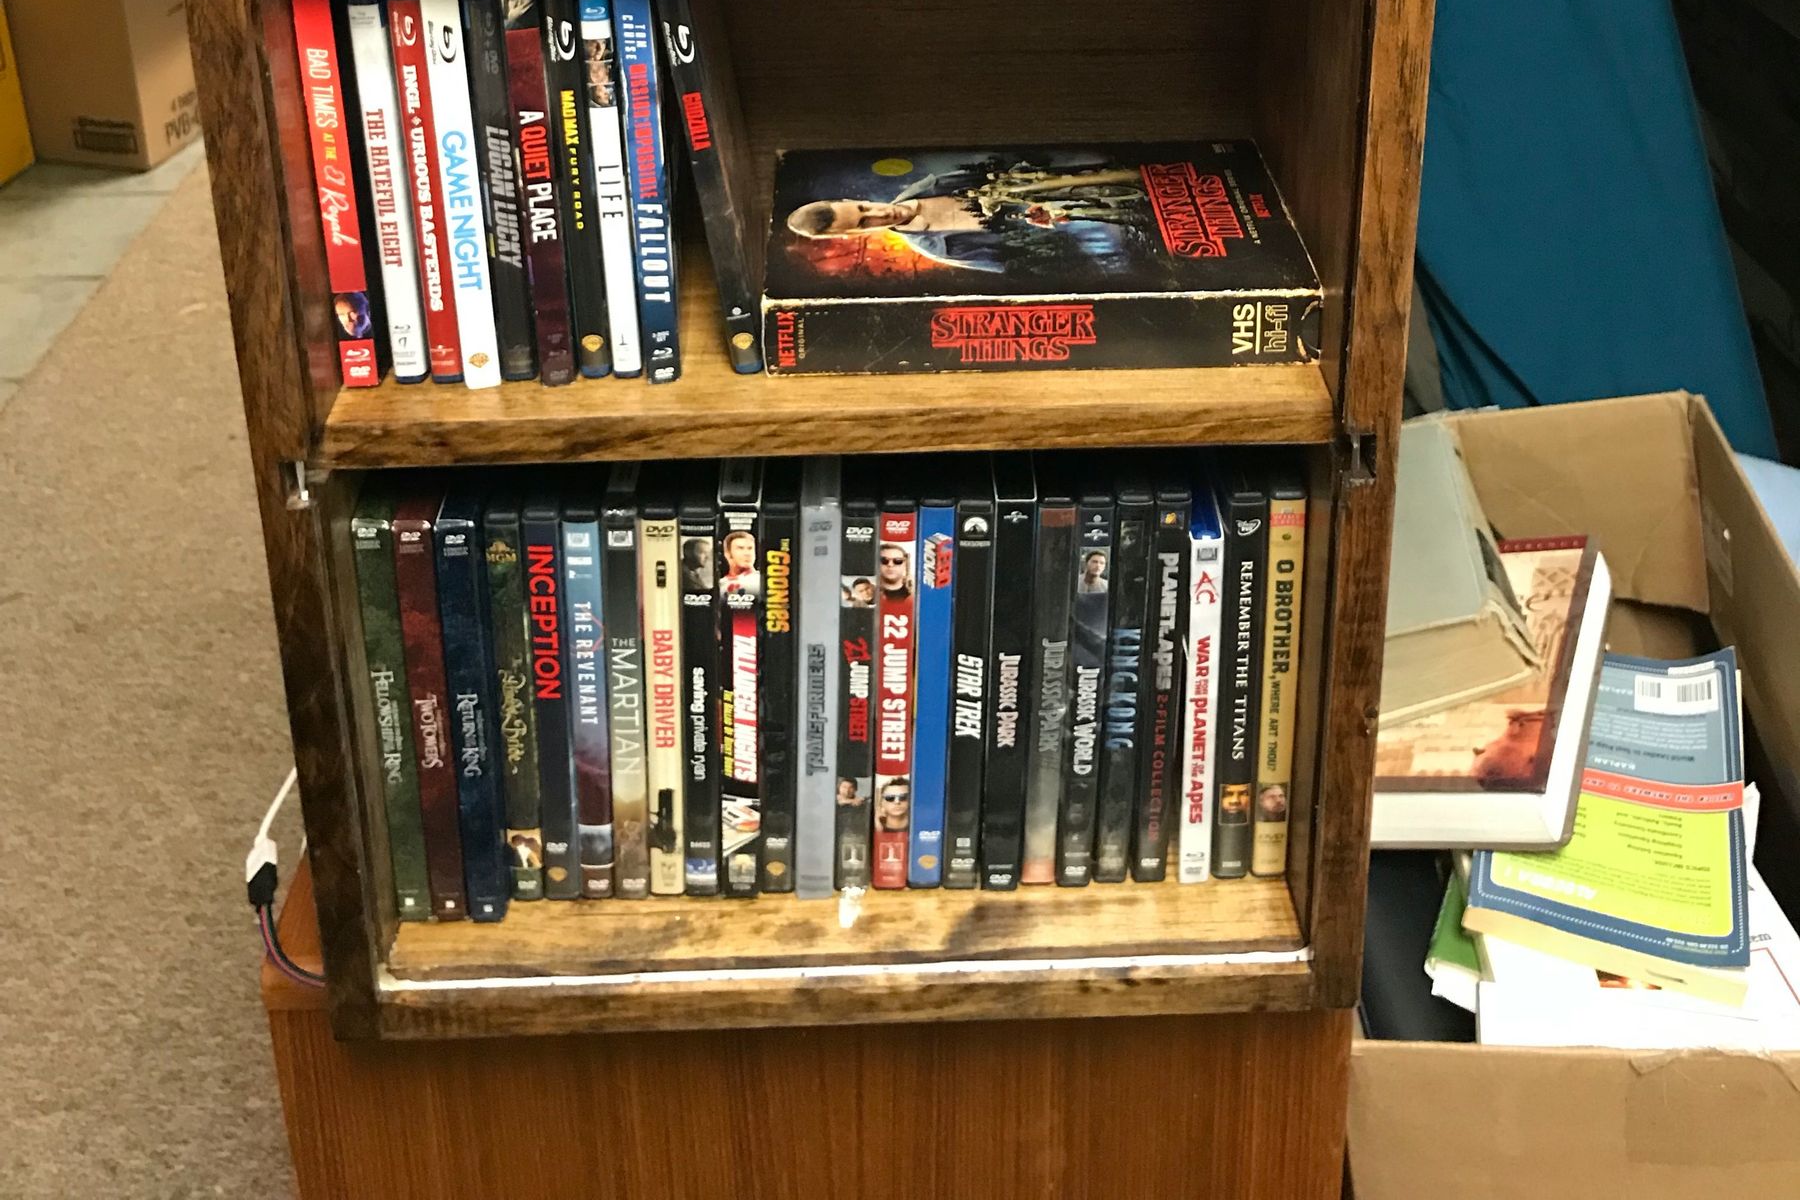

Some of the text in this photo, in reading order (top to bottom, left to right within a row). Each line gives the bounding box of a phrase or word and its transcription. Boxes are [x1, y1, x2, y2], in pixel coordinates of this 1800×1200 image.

[622, 14, 637, 60] CRUISE
[635, 24, 647, 48] TOM
[306, 48, 338, 129] BAD TIMES
[366, 108, 403, 267] THE HATEFUL EIGHT
[486, 125, 523, 268] LOGAN LUCKY
[519, 111, 557, 243] A QUIET PLACE
[560, 90, 584, 230] MAD MAX FURY ROAD
[598, 164, 624, 219] LIFE
[442, 130, 482, 291] GAME NIGHT
[637, 202, 671, 302] FALLOUT
[1143, 161, 1226, 257] STRANGER
[1193, 174, 1244, 241] THINGS
[419, 204, 444, 312] BASTERDS
[777, 311, 797, 367] NETFLIX
[931, 306, 1096, 347] STRANGER
[960, 337, 1070, 363] THINGS
[1231, 304, 1256, 354] VHS
[1264, 304, 1288, 352] hi-fi
[766, 550, 790, 633] GOONIES
[923, 539, 936, 589] MOVIE
[1158, 552, 1179, 630] PLANET
[527, 545, 561, 700] INCEPTION
[574, 601, 598, 725] THE REVENANT
[612, 638, 636, 647] THE
[1231, 560, 1254, 761] REMEMBER THE TITANS
[1268, 559, 1295, 737] O WHERE ART
[371, 671, 394, 735] FELLOWSHIP
[456, 693, 478, 738] RETURN
[611, 649, 641, 775] MARTIAN
[652, 629, 676, 749] BABY DRIVER
[690, 667, 708, 781] saving private ryan
[849, 662, 869, 699] JUMP
[881, 614, 909, 762] 22 JUMP STREET
[955, 654, 984, 740] STAR TREK
[996, 652, 1021, 748] JURASSIC PARK
[1072, 665, 1100, 776] JURASSIC WORLD
[420, 723, 444, 769] TOWERS
[1186, 635, 1211, 824] WAR PLANET APES
